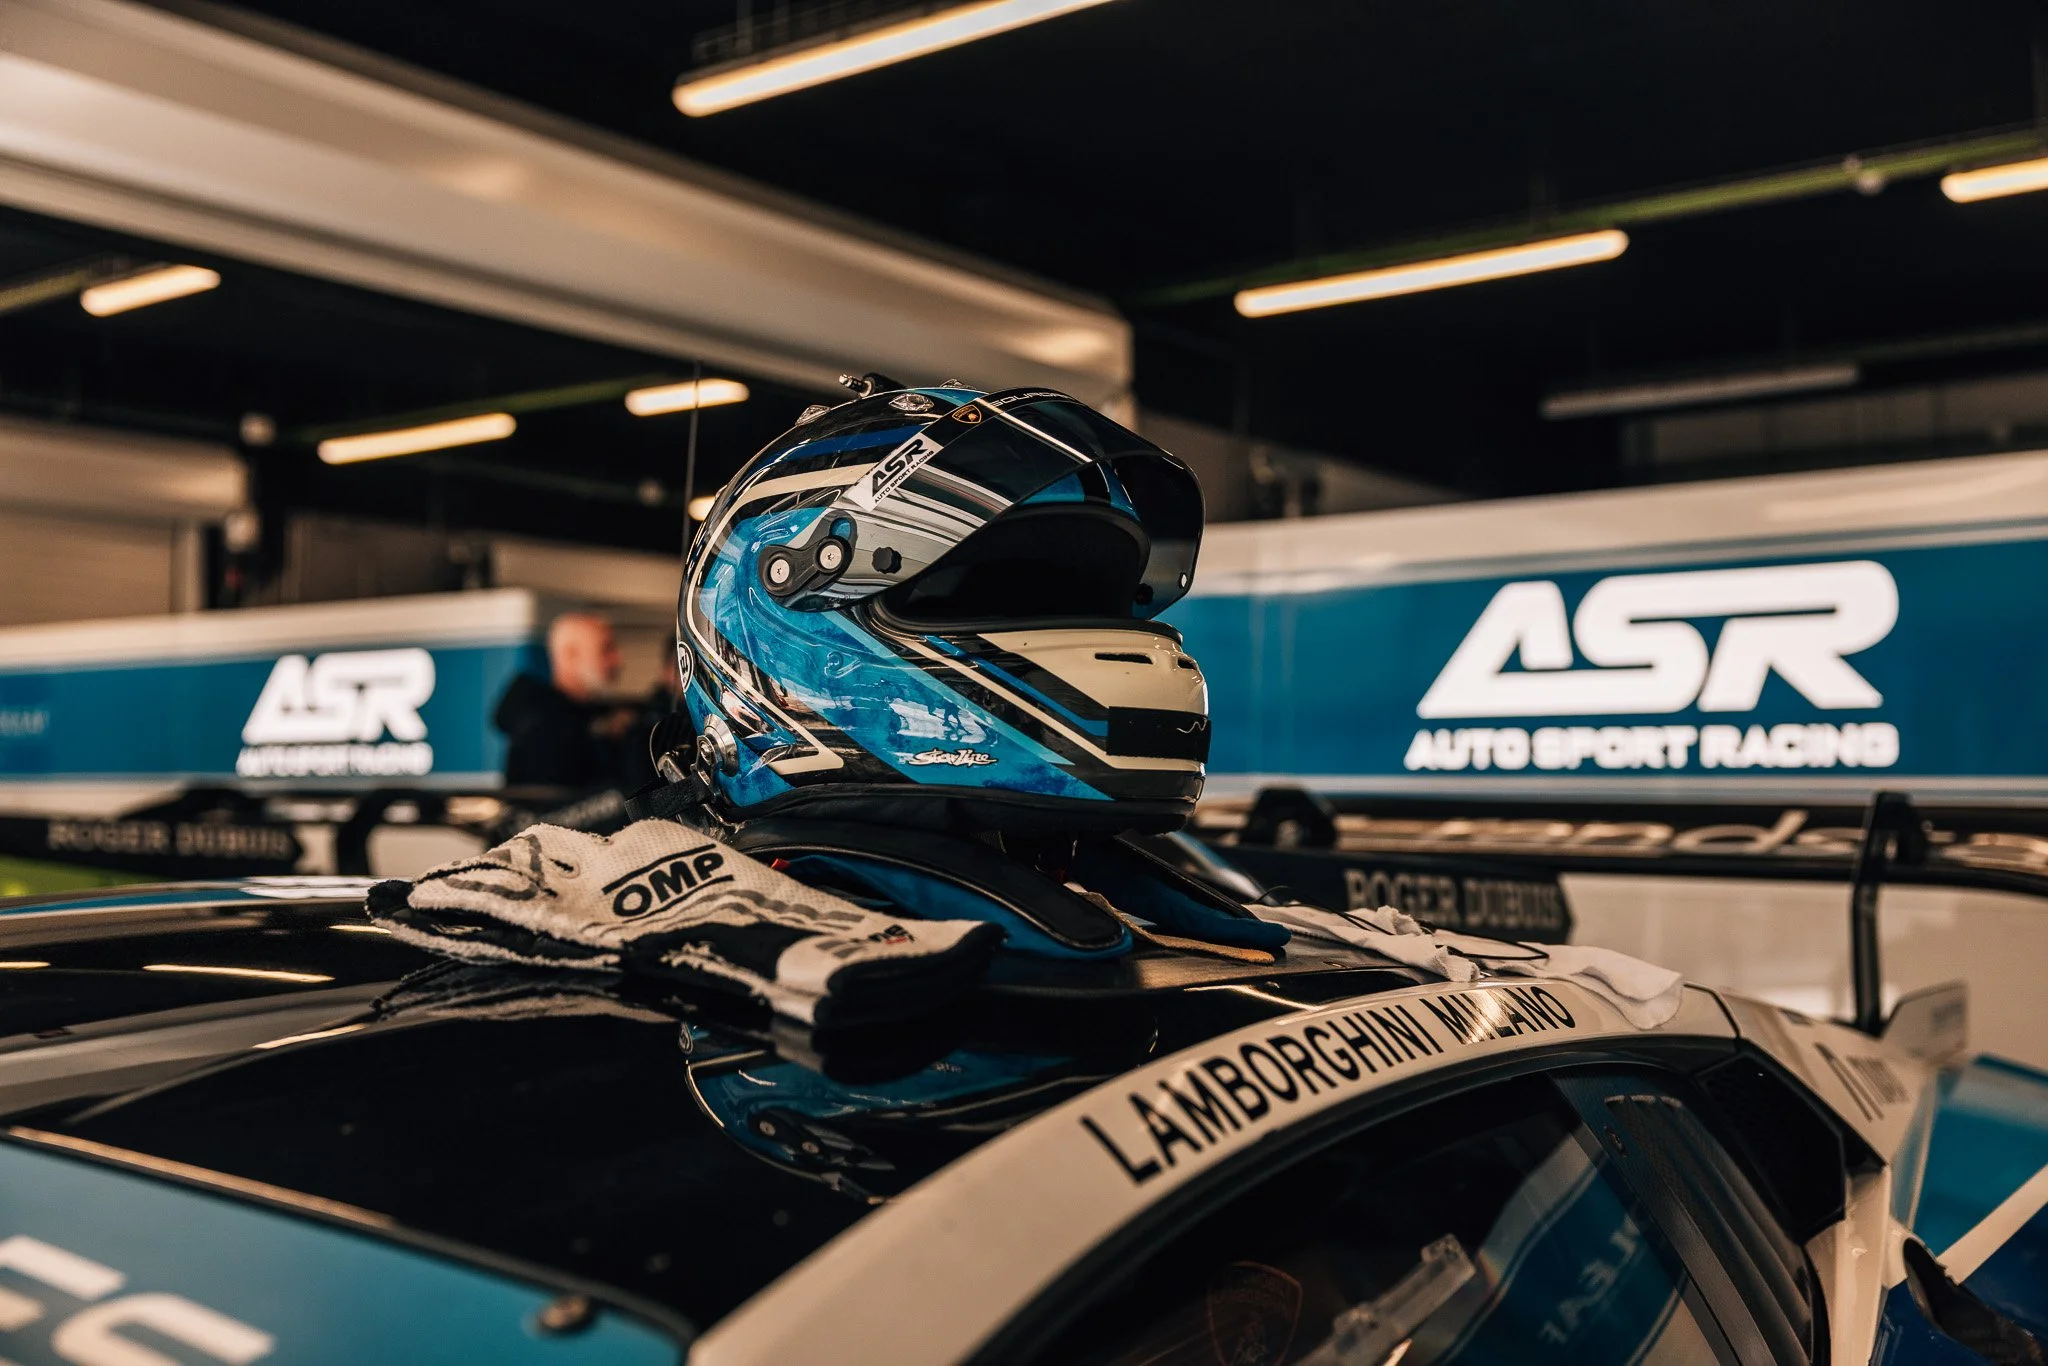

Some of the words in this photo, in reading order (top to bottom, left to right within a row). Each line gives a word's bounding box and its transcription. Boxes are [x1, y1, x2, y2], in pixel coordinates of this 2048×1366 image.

[872, 438, 929, 497] ASR
[874, 487, 891, 504] AUTO
[891, 469, 911, 488] SPORT
[912, 450, 935, 470] RACING
[1416, 560, 1899, 720] ASR
[240, 647, 436, 745] ASR
[1403, 728, 1530, 771] AUTO
[1531, 725, 1698, 771] SPORT
[1700, 722, 1900, 769] RACING
[612, 852, 725, 918] OMP
[1079, 1004, 1445, 1186] LAMBORGHINI
[1418, 985, 1577, 1046] MILANO
